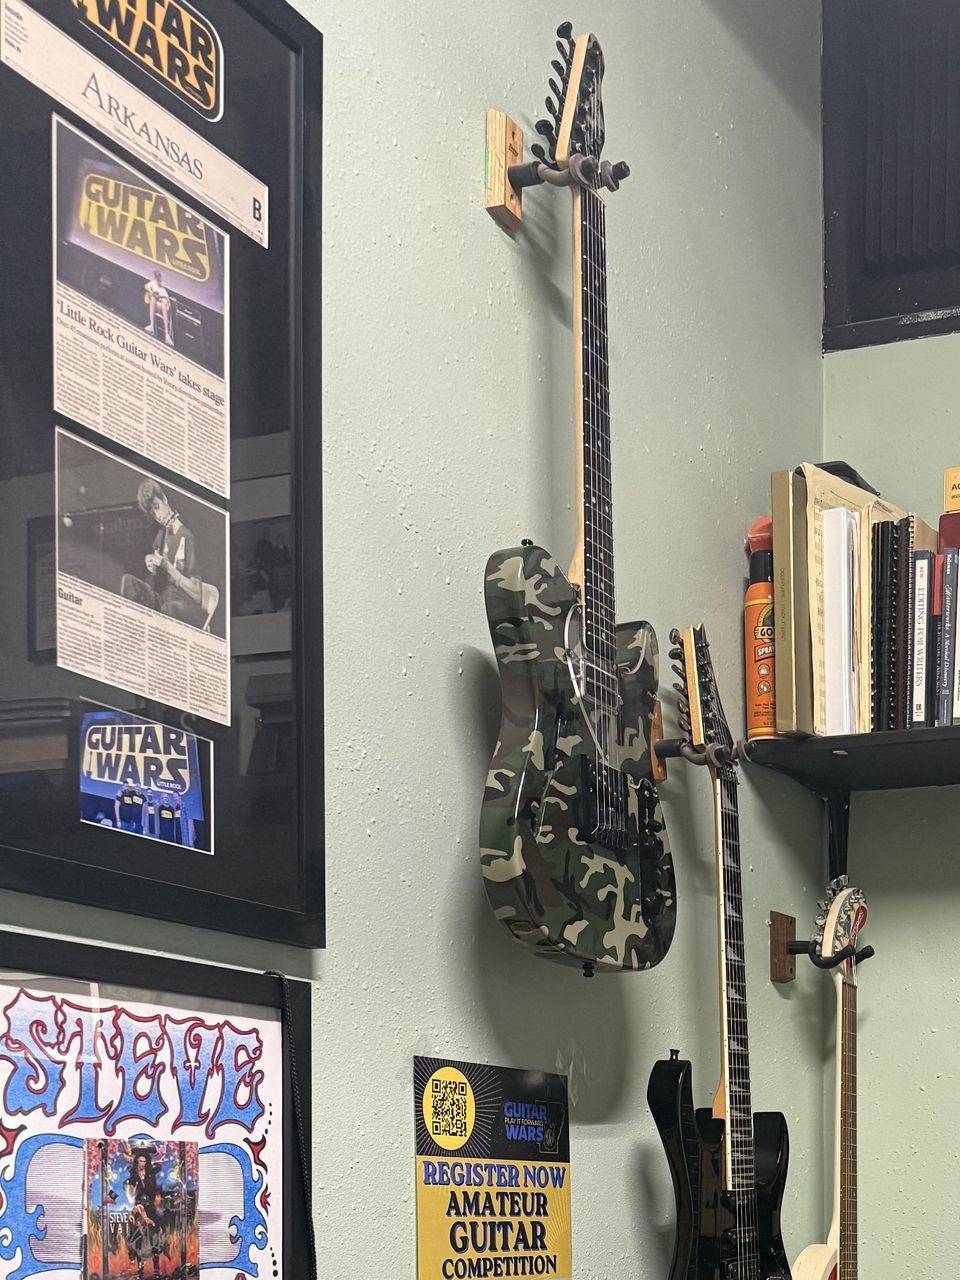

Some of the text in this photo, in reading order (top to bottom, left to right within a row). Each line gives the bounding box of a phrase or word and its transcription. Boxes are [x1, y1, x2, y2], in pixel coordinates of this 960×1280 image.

[96, 0, 214, 107] WARS
[82, 72, 203, 180] ARKANSAS
[84, 175, 207, 238] GUITAR
[252, 197, 262, 222] B
[95, 204, 209, 279] WARS
[89, 318, 115, 343] Rock
[116, 334, 149, 361] Guitar
[178, 371, 202, 394] takes
[203, 387, 225, 407] stage
[58, 587, 83, 606] Guitar
[916, 587, 925, 625] EDITING
[915, 627, 924, 646] FOR
[914, 647, 923, 687] WRITERS
[86, 725, 187, 756] GUITAR
[95, 751, 188, 793] WARS
[0, 988, 265, 1138] STEVE
[504, 1101, 547, 1120] GUITAR
[504, 1117, 516, 1125] PLAY
[504, 1125, 544, 1143] WARS
[423, 1160, 567, 1189] REGISTER NOW
[109, 1212, 129, 1224] STEVE
[446, 1191, 549, 1217] AMATEUR
[449, 1221, 548, 1254] GUITAR
[442, 1255, 557, 1280] COMPETITION
